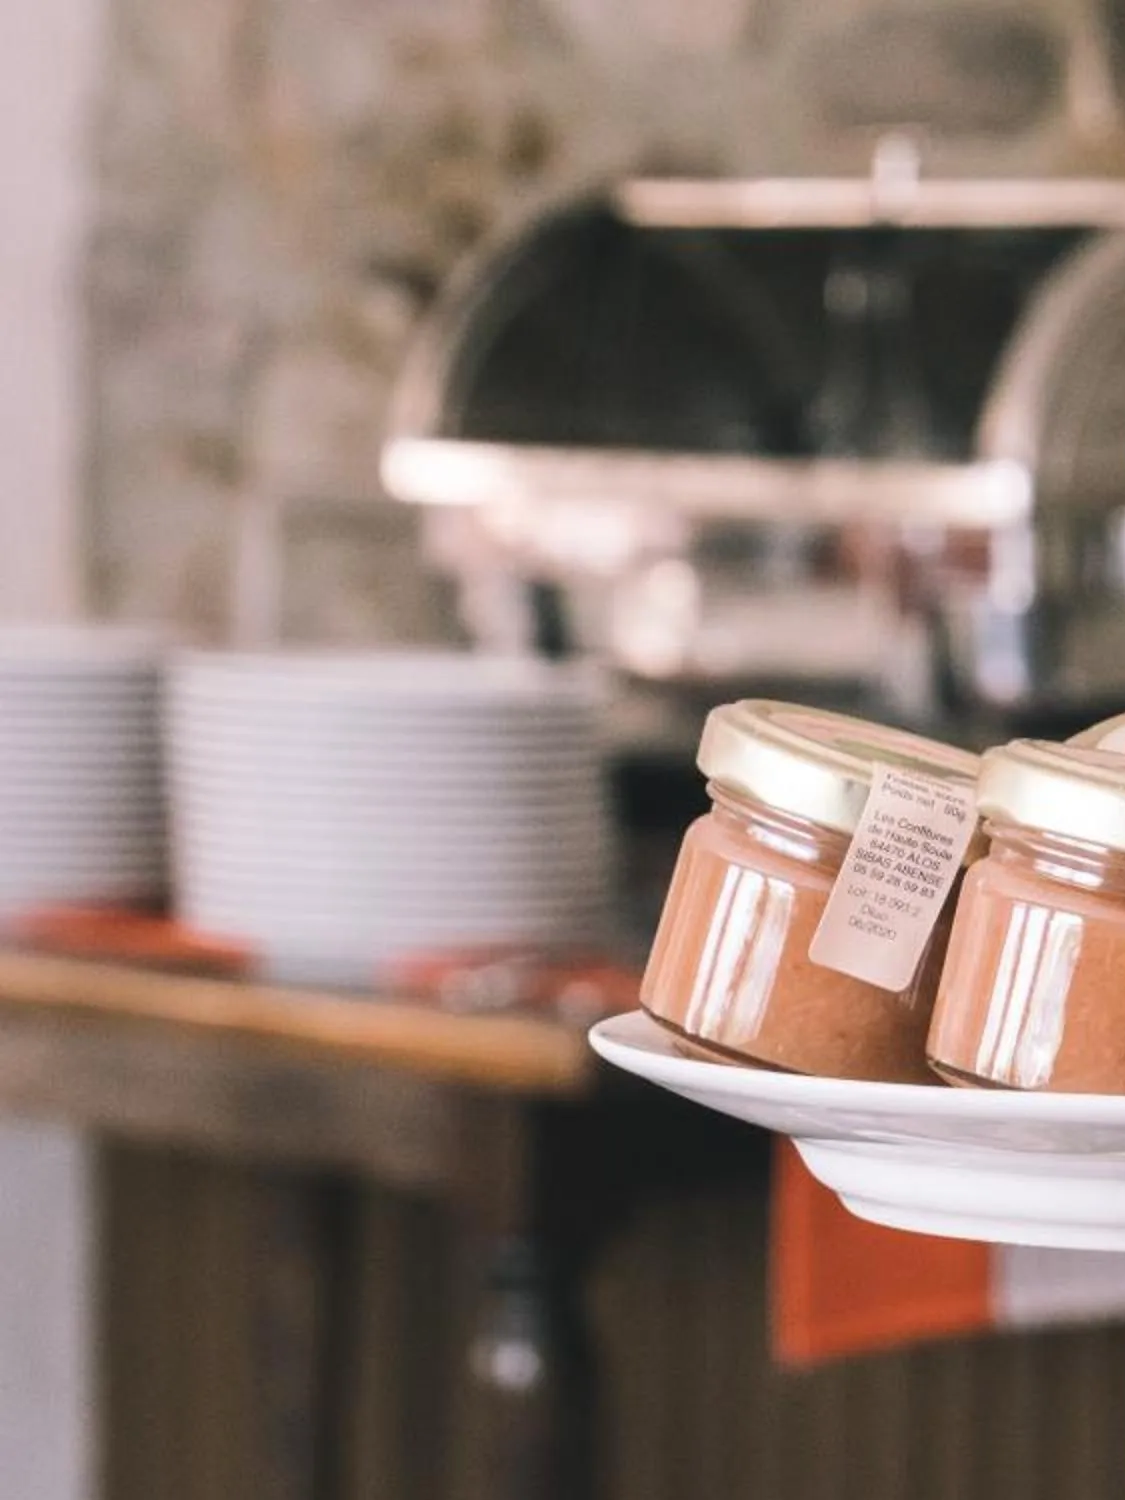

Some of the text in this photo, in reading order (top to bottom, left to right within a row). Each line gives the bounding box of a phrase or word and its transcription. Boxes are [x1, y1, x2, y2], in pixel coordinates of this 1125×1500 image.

[898, 817, 954, 845] Confitures
[855, 848, 944, 889] SIBAS ABENSE
[907, 852, 940, 871] ALOS
